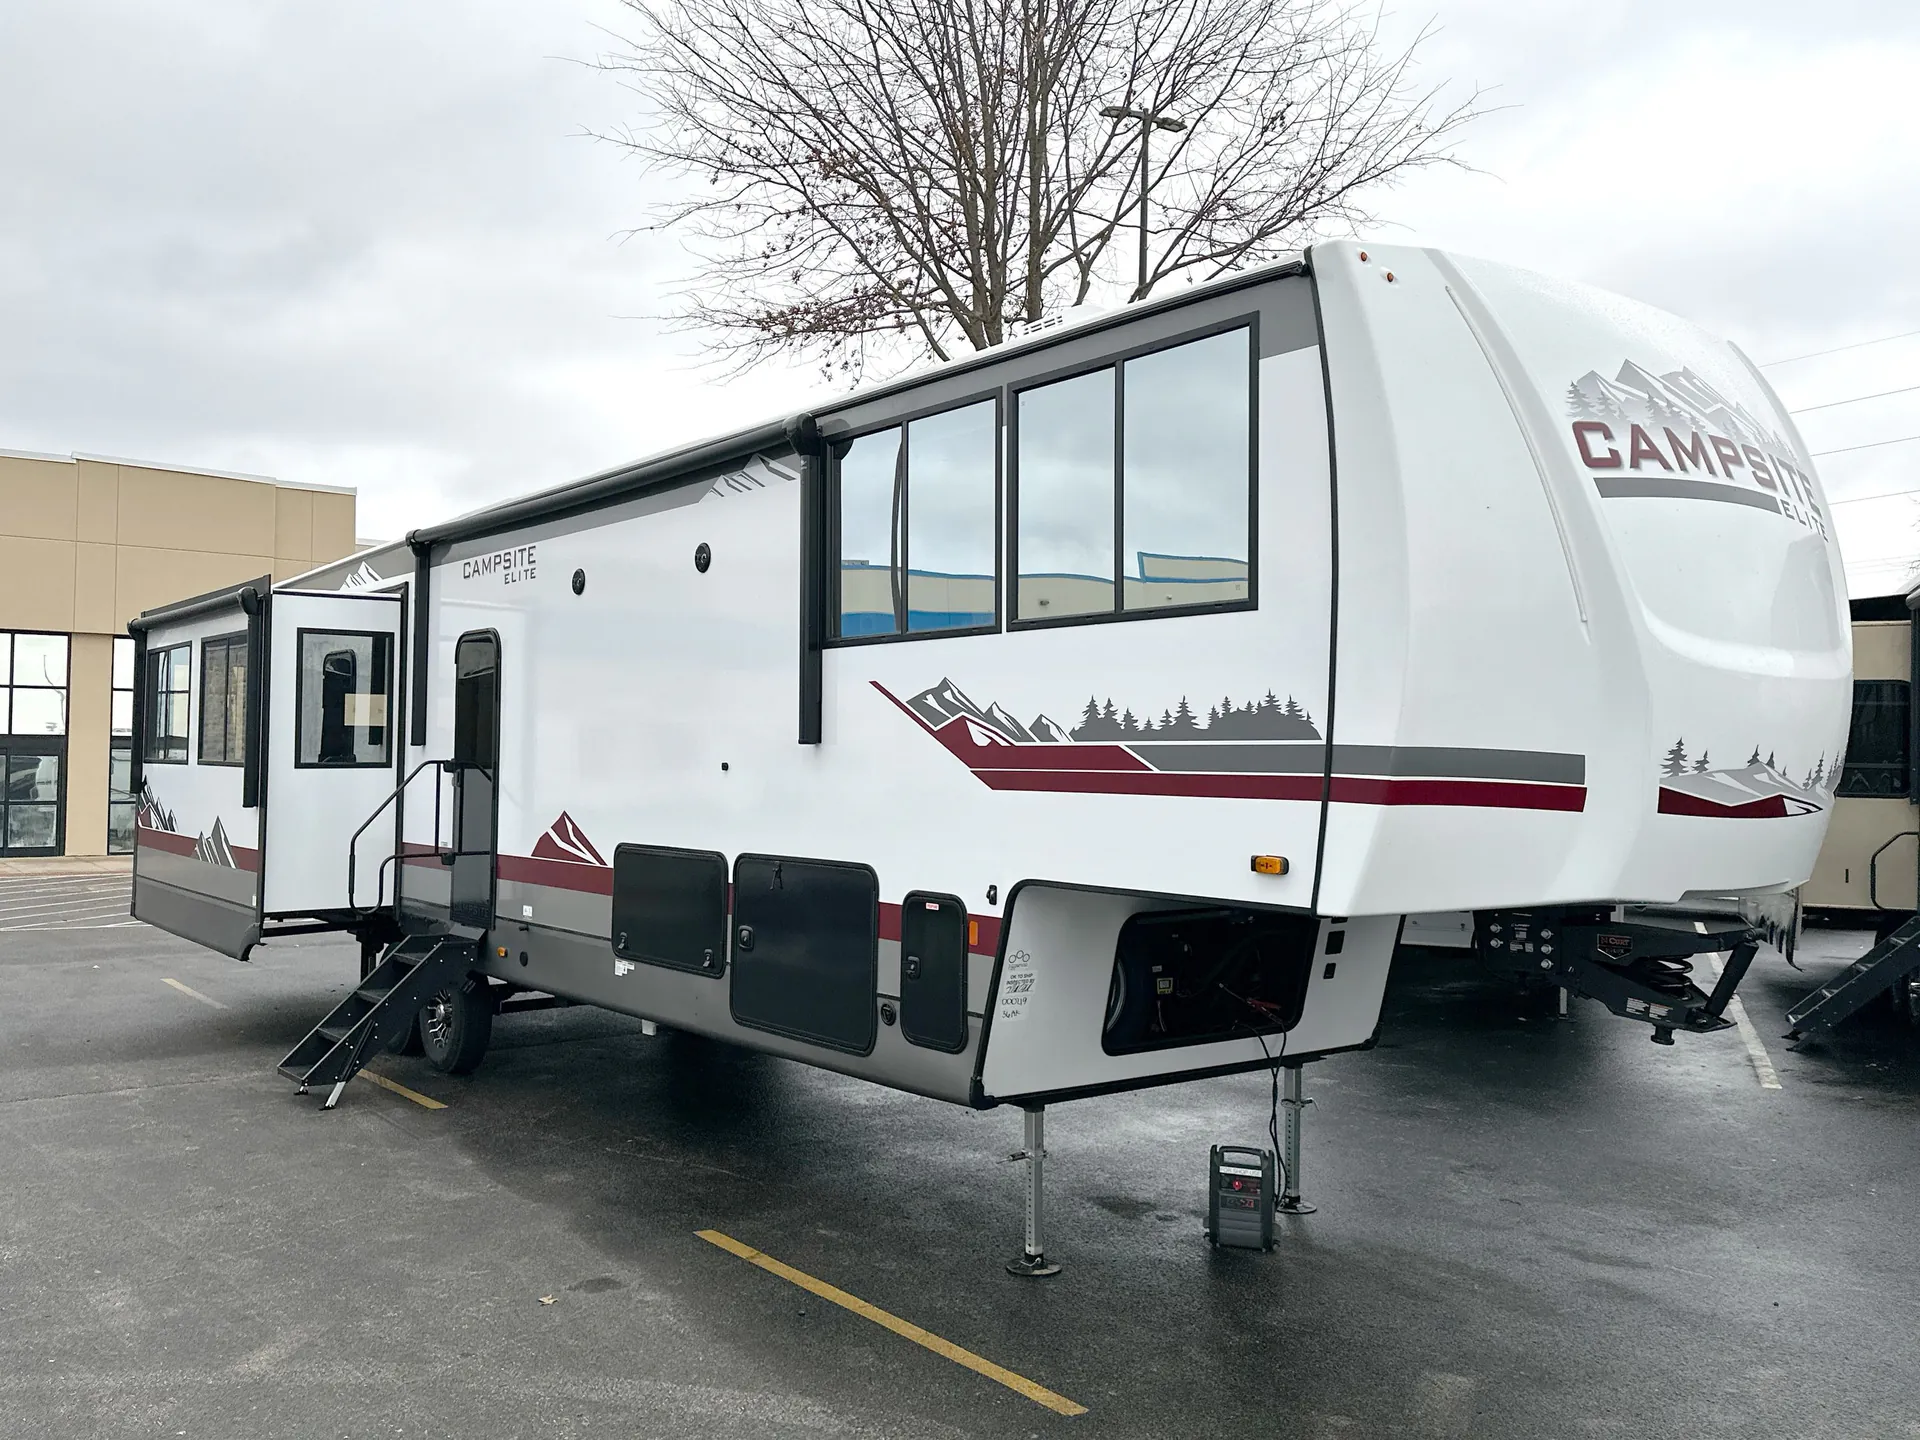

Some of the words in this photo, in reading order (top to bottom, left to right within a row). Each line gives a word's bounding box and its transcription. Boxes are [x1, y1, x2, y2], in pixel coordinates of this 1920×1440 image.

[1571, 420, 1822, 519] CAMPSITE
[1779, 498, 1829, 542] ELITE
[463, 545, 537, 579] CAMPSITE
[504, 567, 537, 585] ELITE
